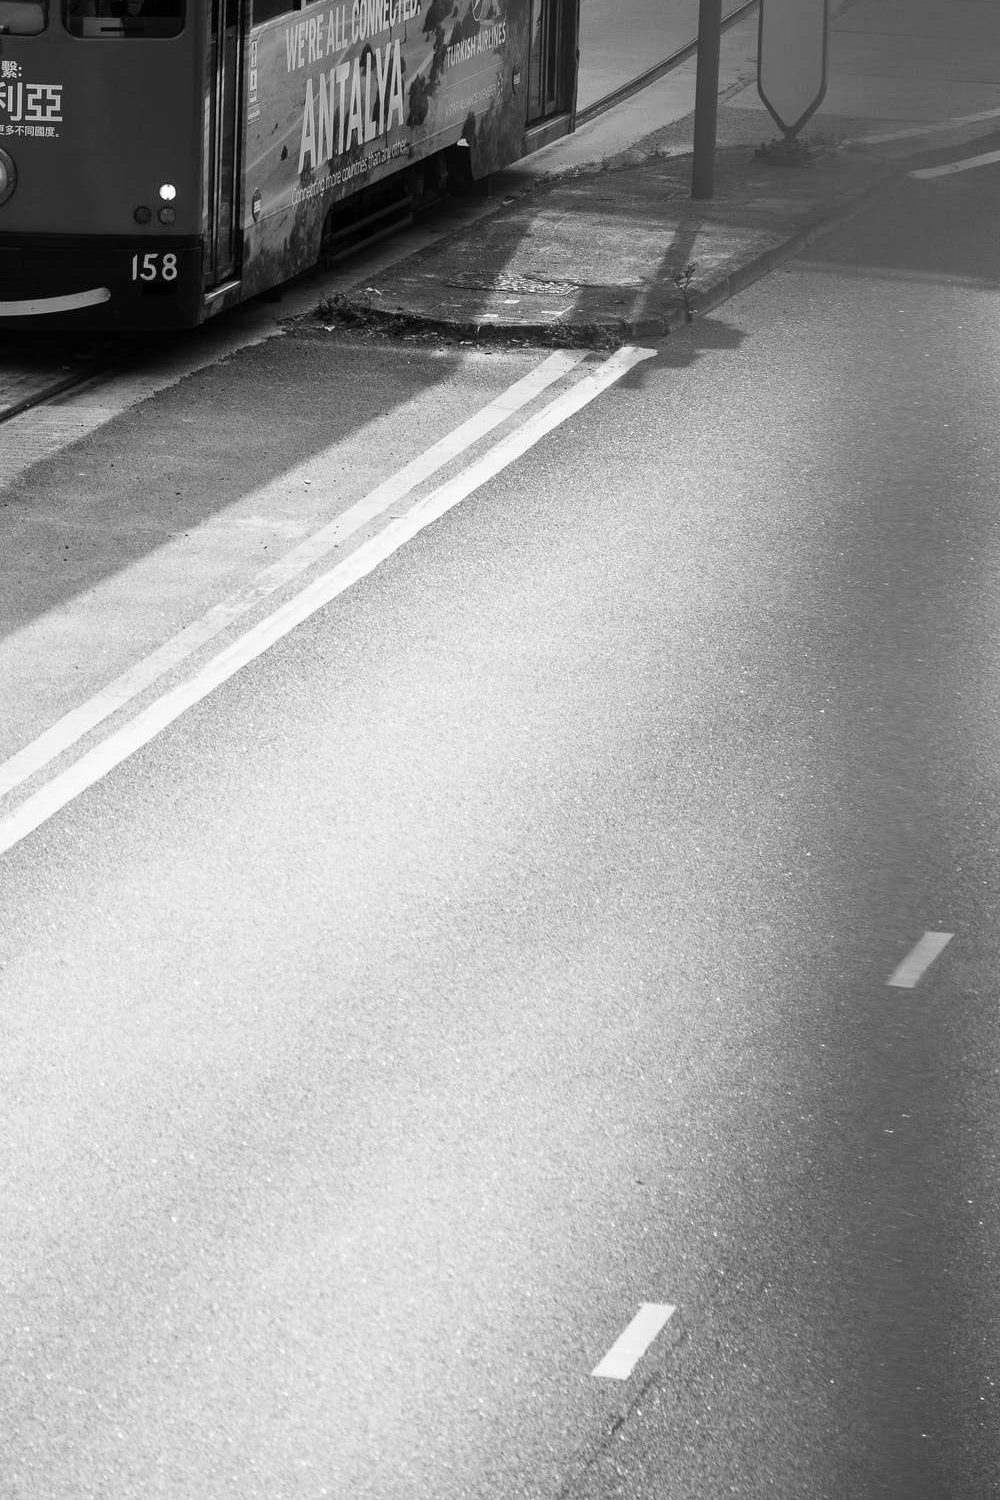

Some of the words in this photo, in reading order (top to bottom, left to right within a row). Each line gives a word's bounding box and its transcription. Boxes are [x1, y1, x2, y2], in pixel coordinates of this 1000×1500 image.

[286, 14, 324, 73] WE'RE
[326, 5, 349, 56] ALL
[447, 35, 476, 68] TURKISH
[477, 21, 506, 56] AIRLINES
[298, 39, 404, 174] ANTALYA
[131, 253, 178, 283] 158
